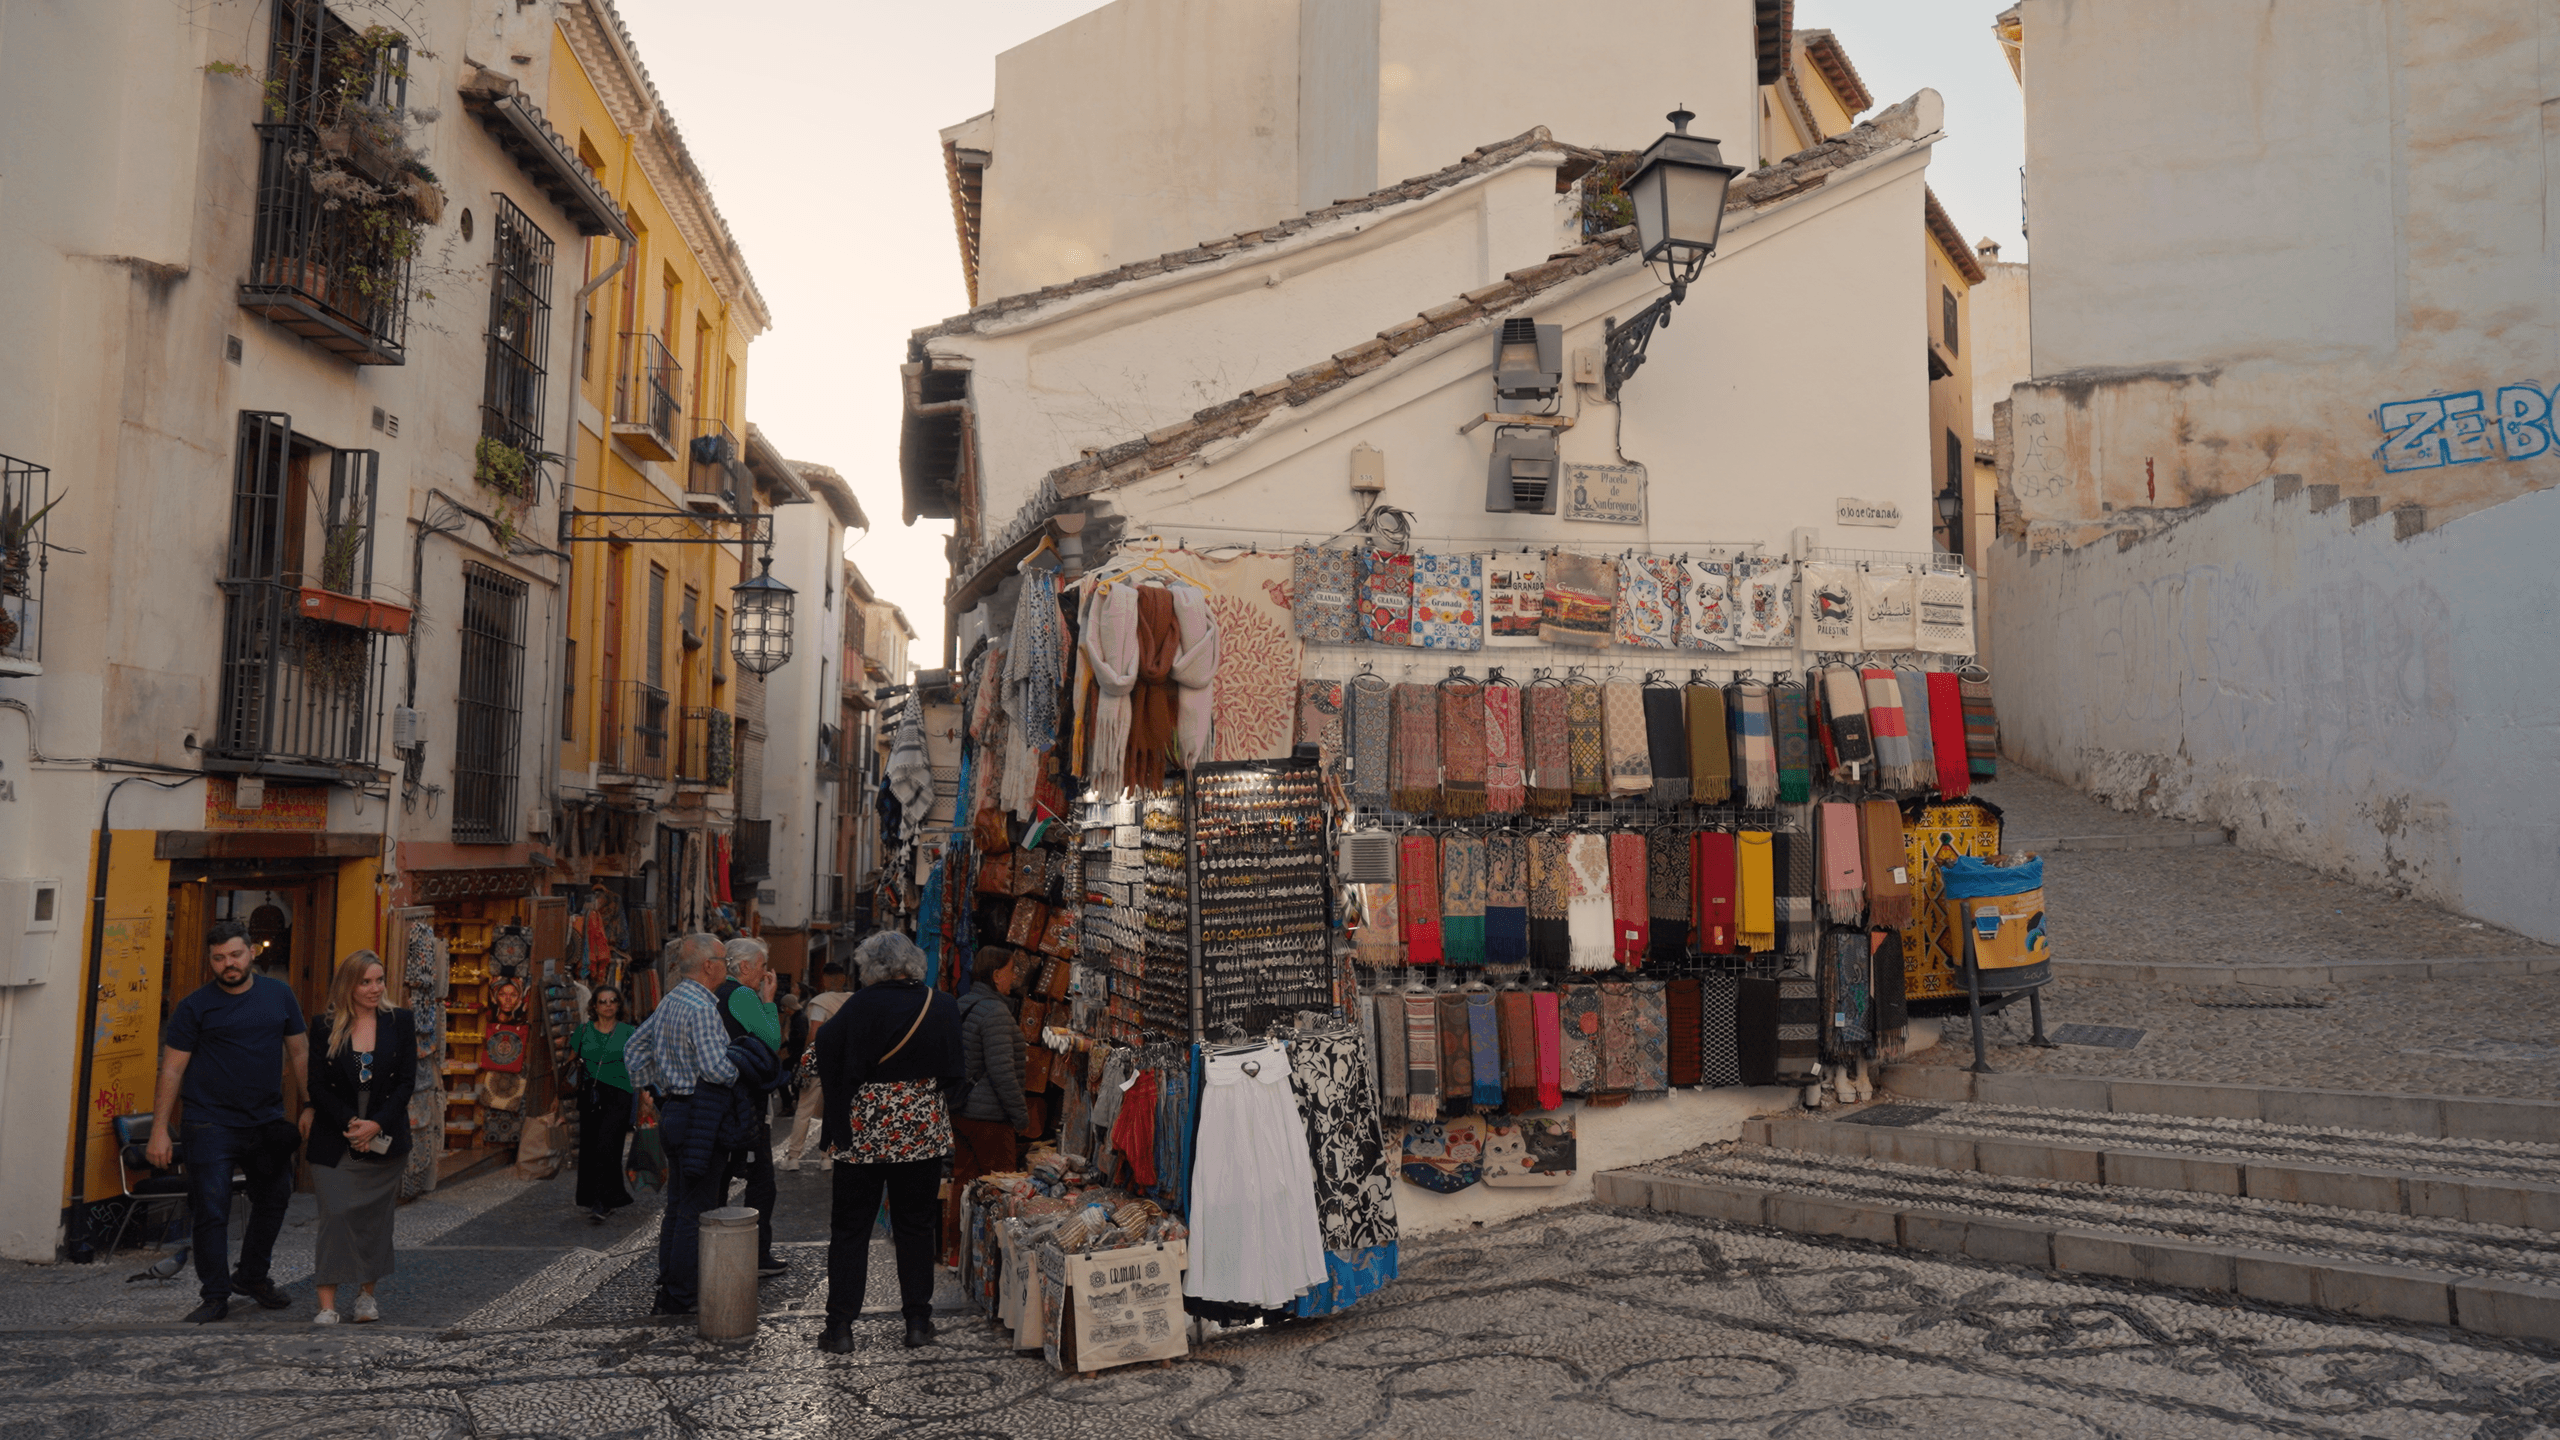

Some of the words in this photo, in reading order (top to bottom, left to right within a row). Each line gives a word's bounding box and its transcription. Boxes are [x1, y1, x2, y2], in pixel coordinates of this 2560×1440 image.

[2379, 383, 2560, 473] ZEB
[1601, 472, 1628, 484] Placeta
[1610, 485, 1620, 496] de
[1593, 496, 1607, 509] San
[1607, 498, 1637, 513] Gregorio
[1513, 581, 1546, 591] GRANADA
[1555, 581, 1597, 596] Granada
[1316, 594, 1342, 604] GRANADA
[1377, 596, 1404, 606] GRANADA
[1431, 598, 1463, 609] Granada
[1817, 625, 1849, 637] PALESTINE
